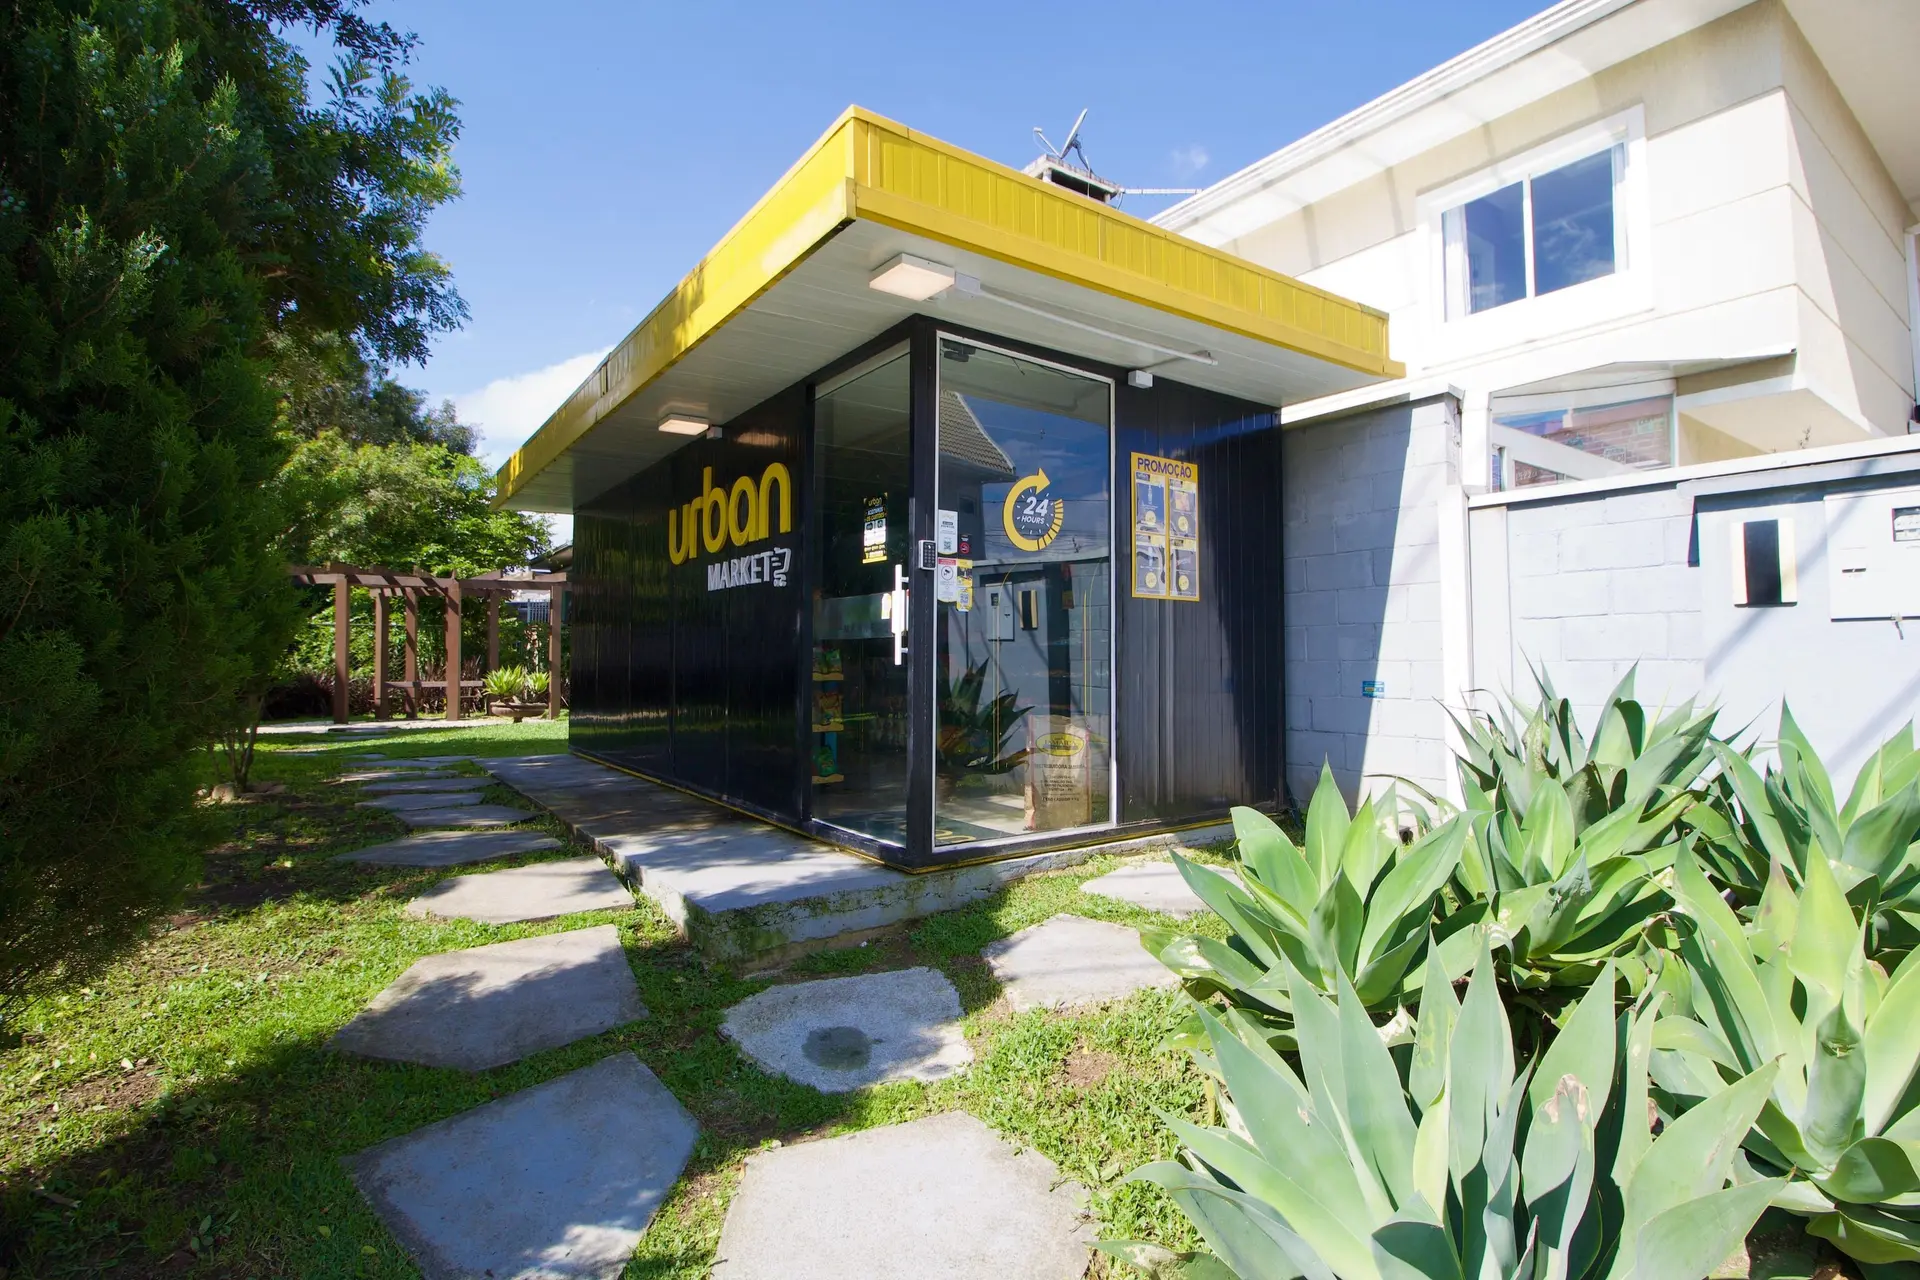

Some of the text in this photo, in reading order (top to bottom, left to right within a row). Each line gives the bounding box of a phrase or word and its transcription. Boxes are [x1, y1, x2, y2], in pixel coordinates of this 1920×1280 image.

[1137, 457, 1192, 479] PROMOÇÃO
[669, 462, 792, 566] urban
[1023, 496, 1049, 517] 24
[1021, 515, 1045, 525] HOURS
[708, 551, 774, 591] MARKET
